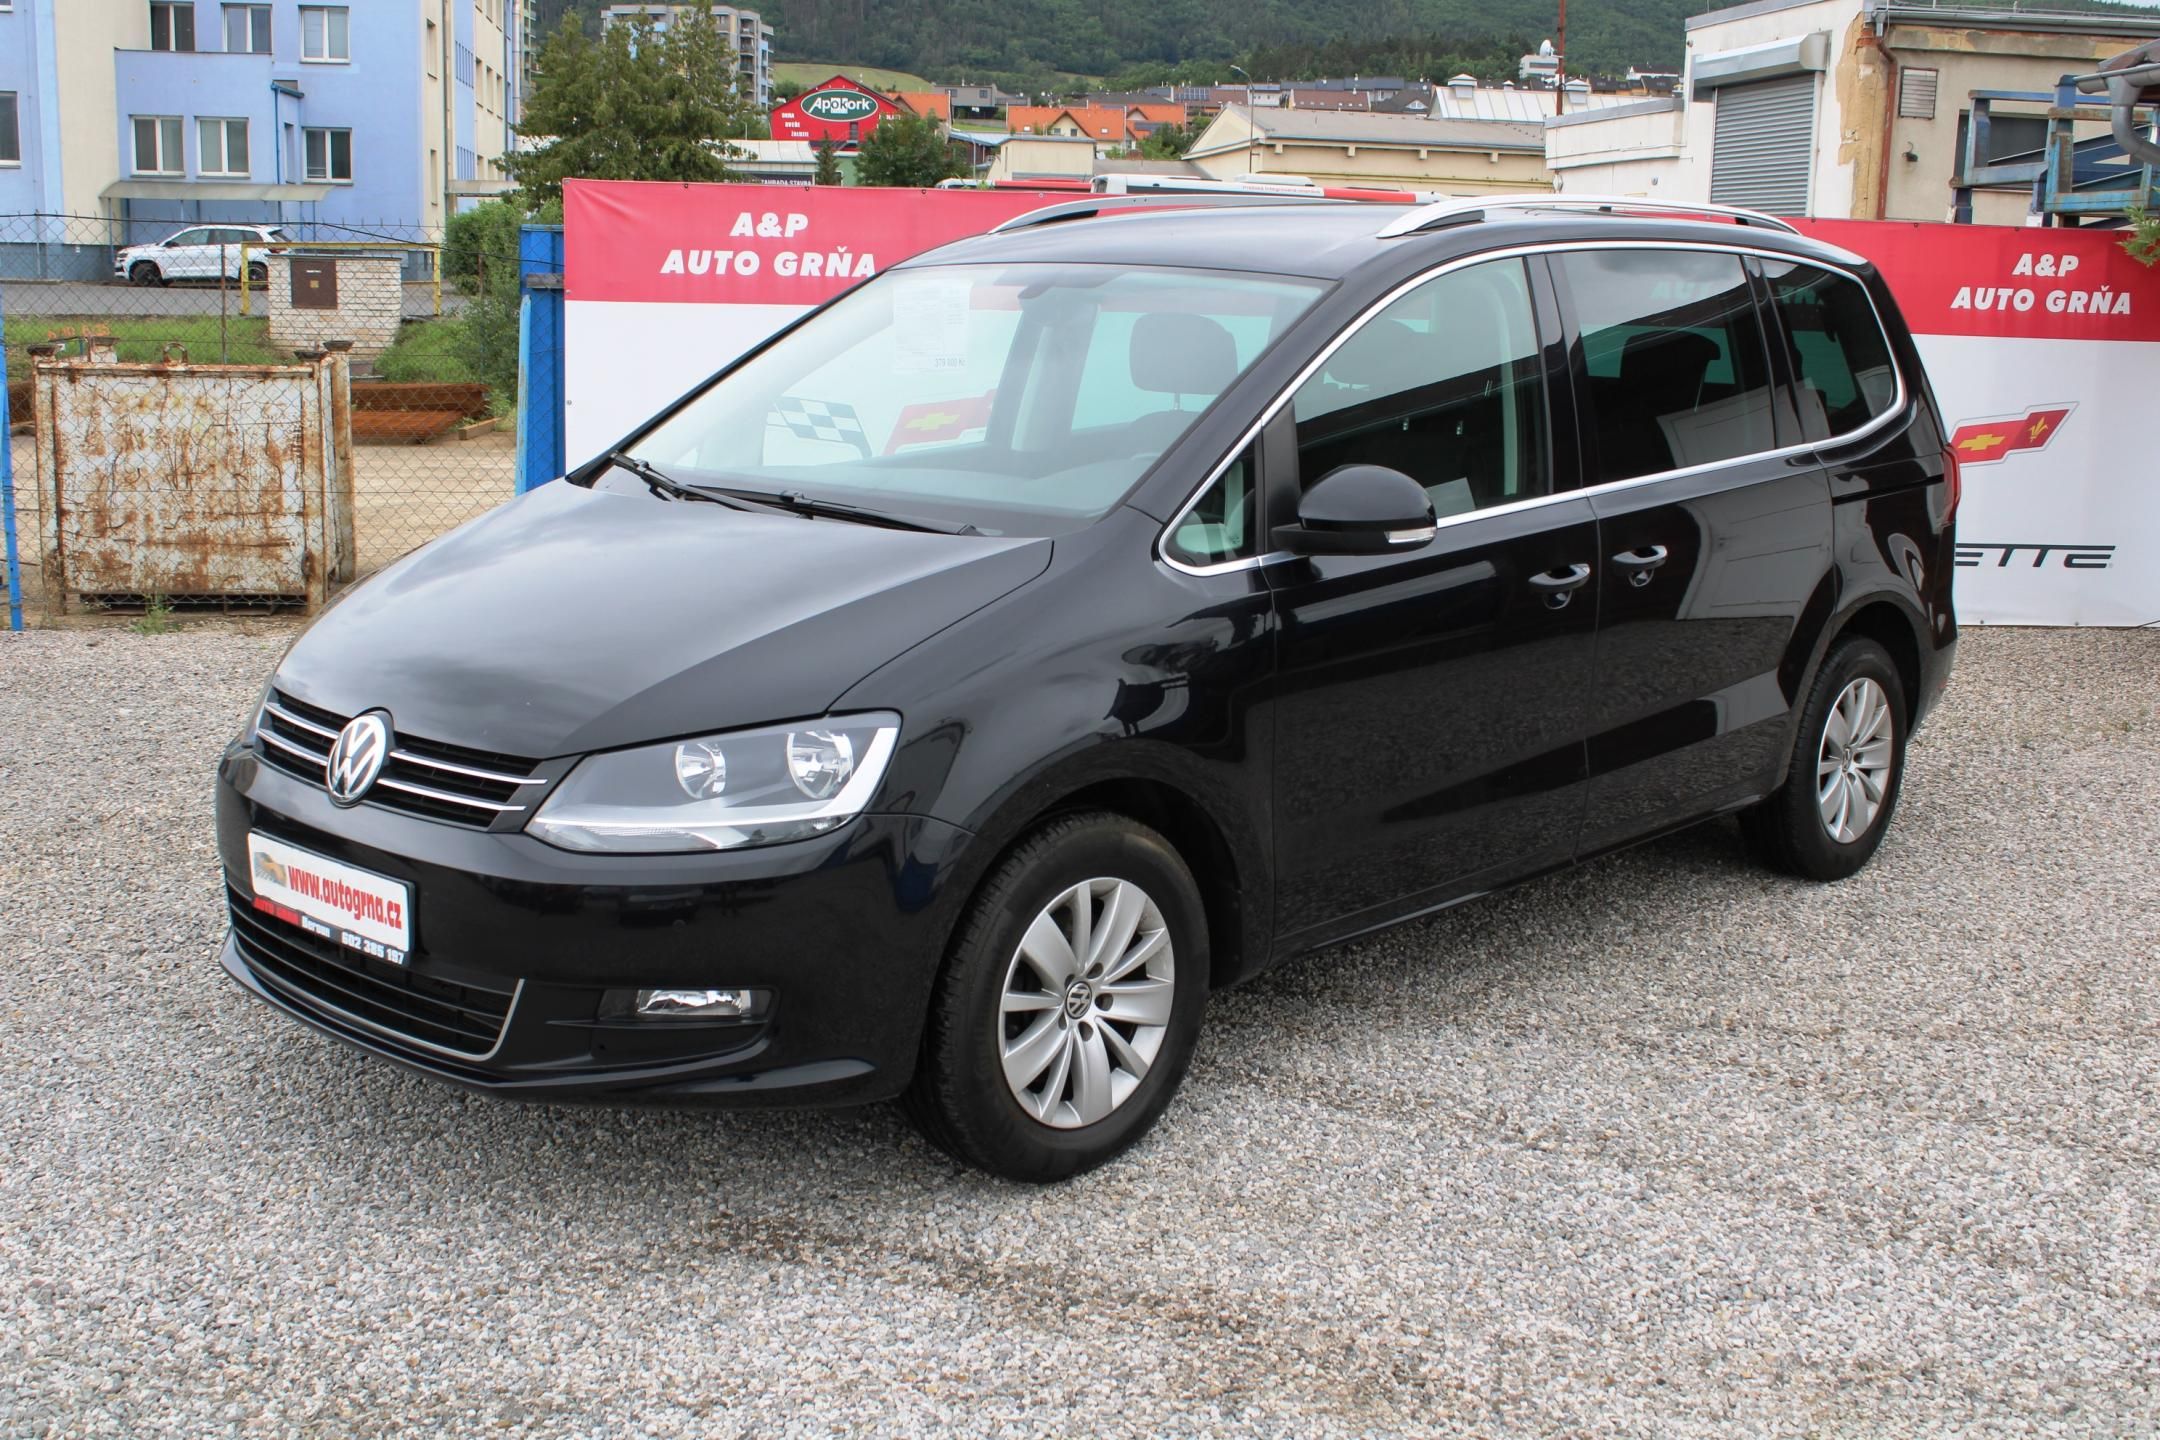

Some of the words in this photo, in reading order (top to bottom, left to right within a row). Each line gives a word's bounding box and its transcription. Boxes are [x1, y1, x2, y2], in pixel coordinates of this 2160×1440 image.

[729, 212, 809, 238] A&P
[660, 249, 760, 276] AUTO
[773, 245, 877, 278] GRŇA
[2012, 253, 2080, 277] A&P
[1950, 286, 2035, 312] AUTO
[2046, 285, 2131, 315] GRŇA
[287, 865, 402, 930] www.autogrna.cz
